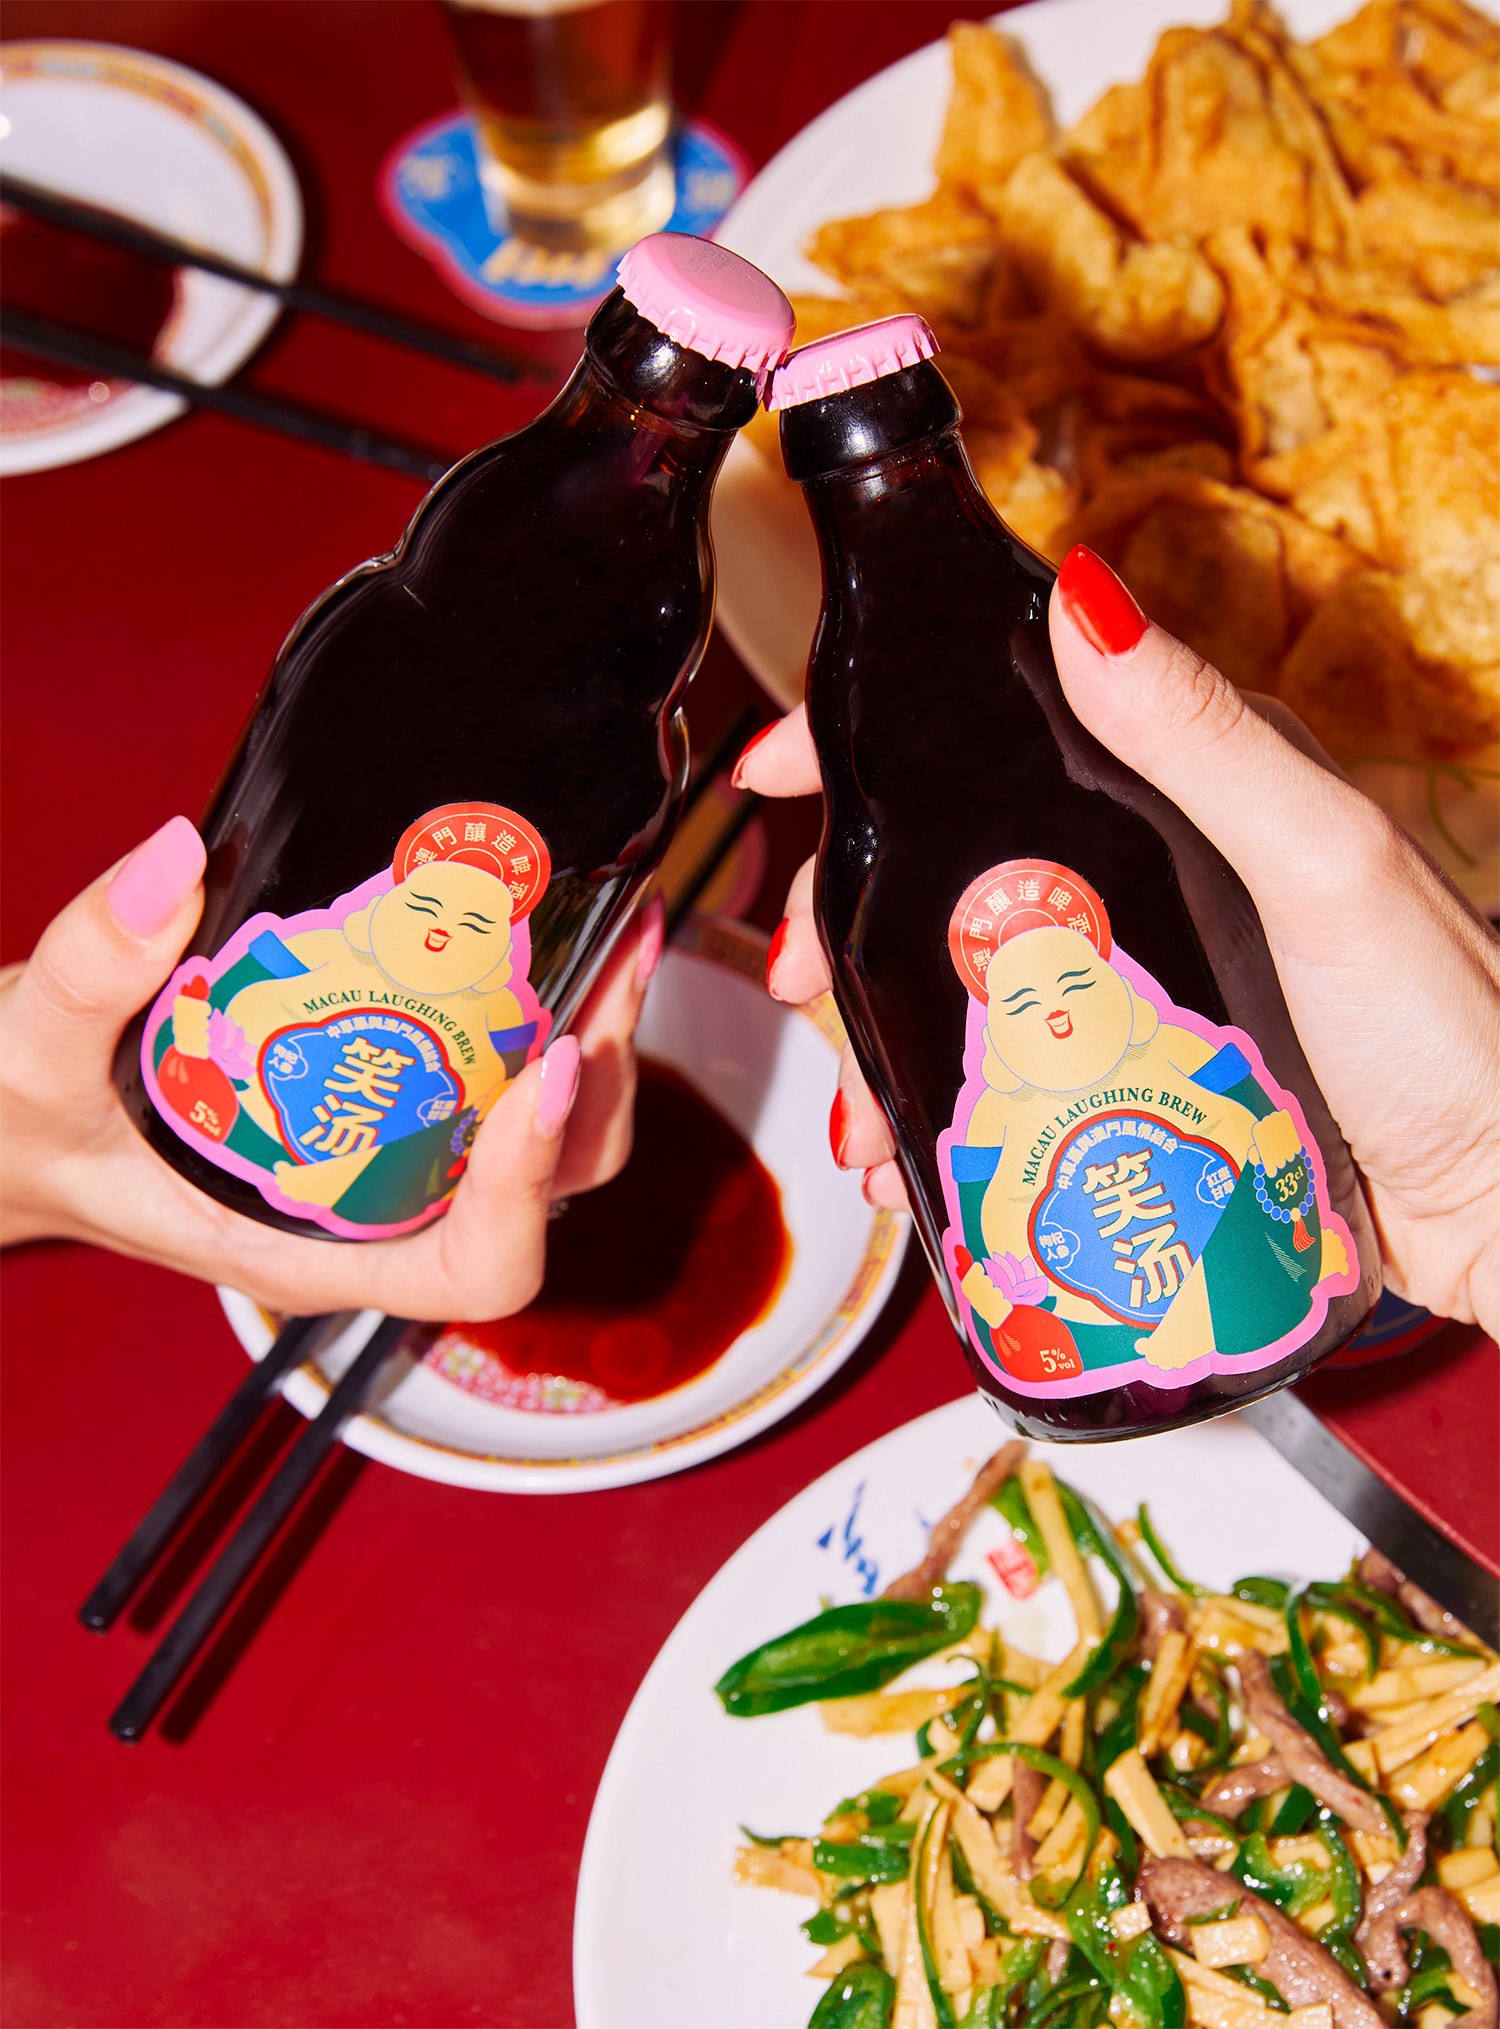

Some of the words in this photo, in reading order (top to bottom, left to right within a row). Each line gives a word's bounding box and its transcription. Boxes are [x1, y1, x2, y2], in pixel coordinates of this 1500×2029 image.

[303, 990, 362, 1014] MACAU
[369, 991, 457, 1032] LAUGHING
[453, 1030, 477, 1066] BREW
[1022, 1125, 1057, 1187] MACAU
[1054, 1087, 1154, 1129] LAUGHING
[1158, 1091, 1207, 1125] BREW
[1275, 1166, 1304, 1202] 33cl
[1040, 1348, 1066, 1373] 5%
[1058, 1358, 1076, 1370] vol
